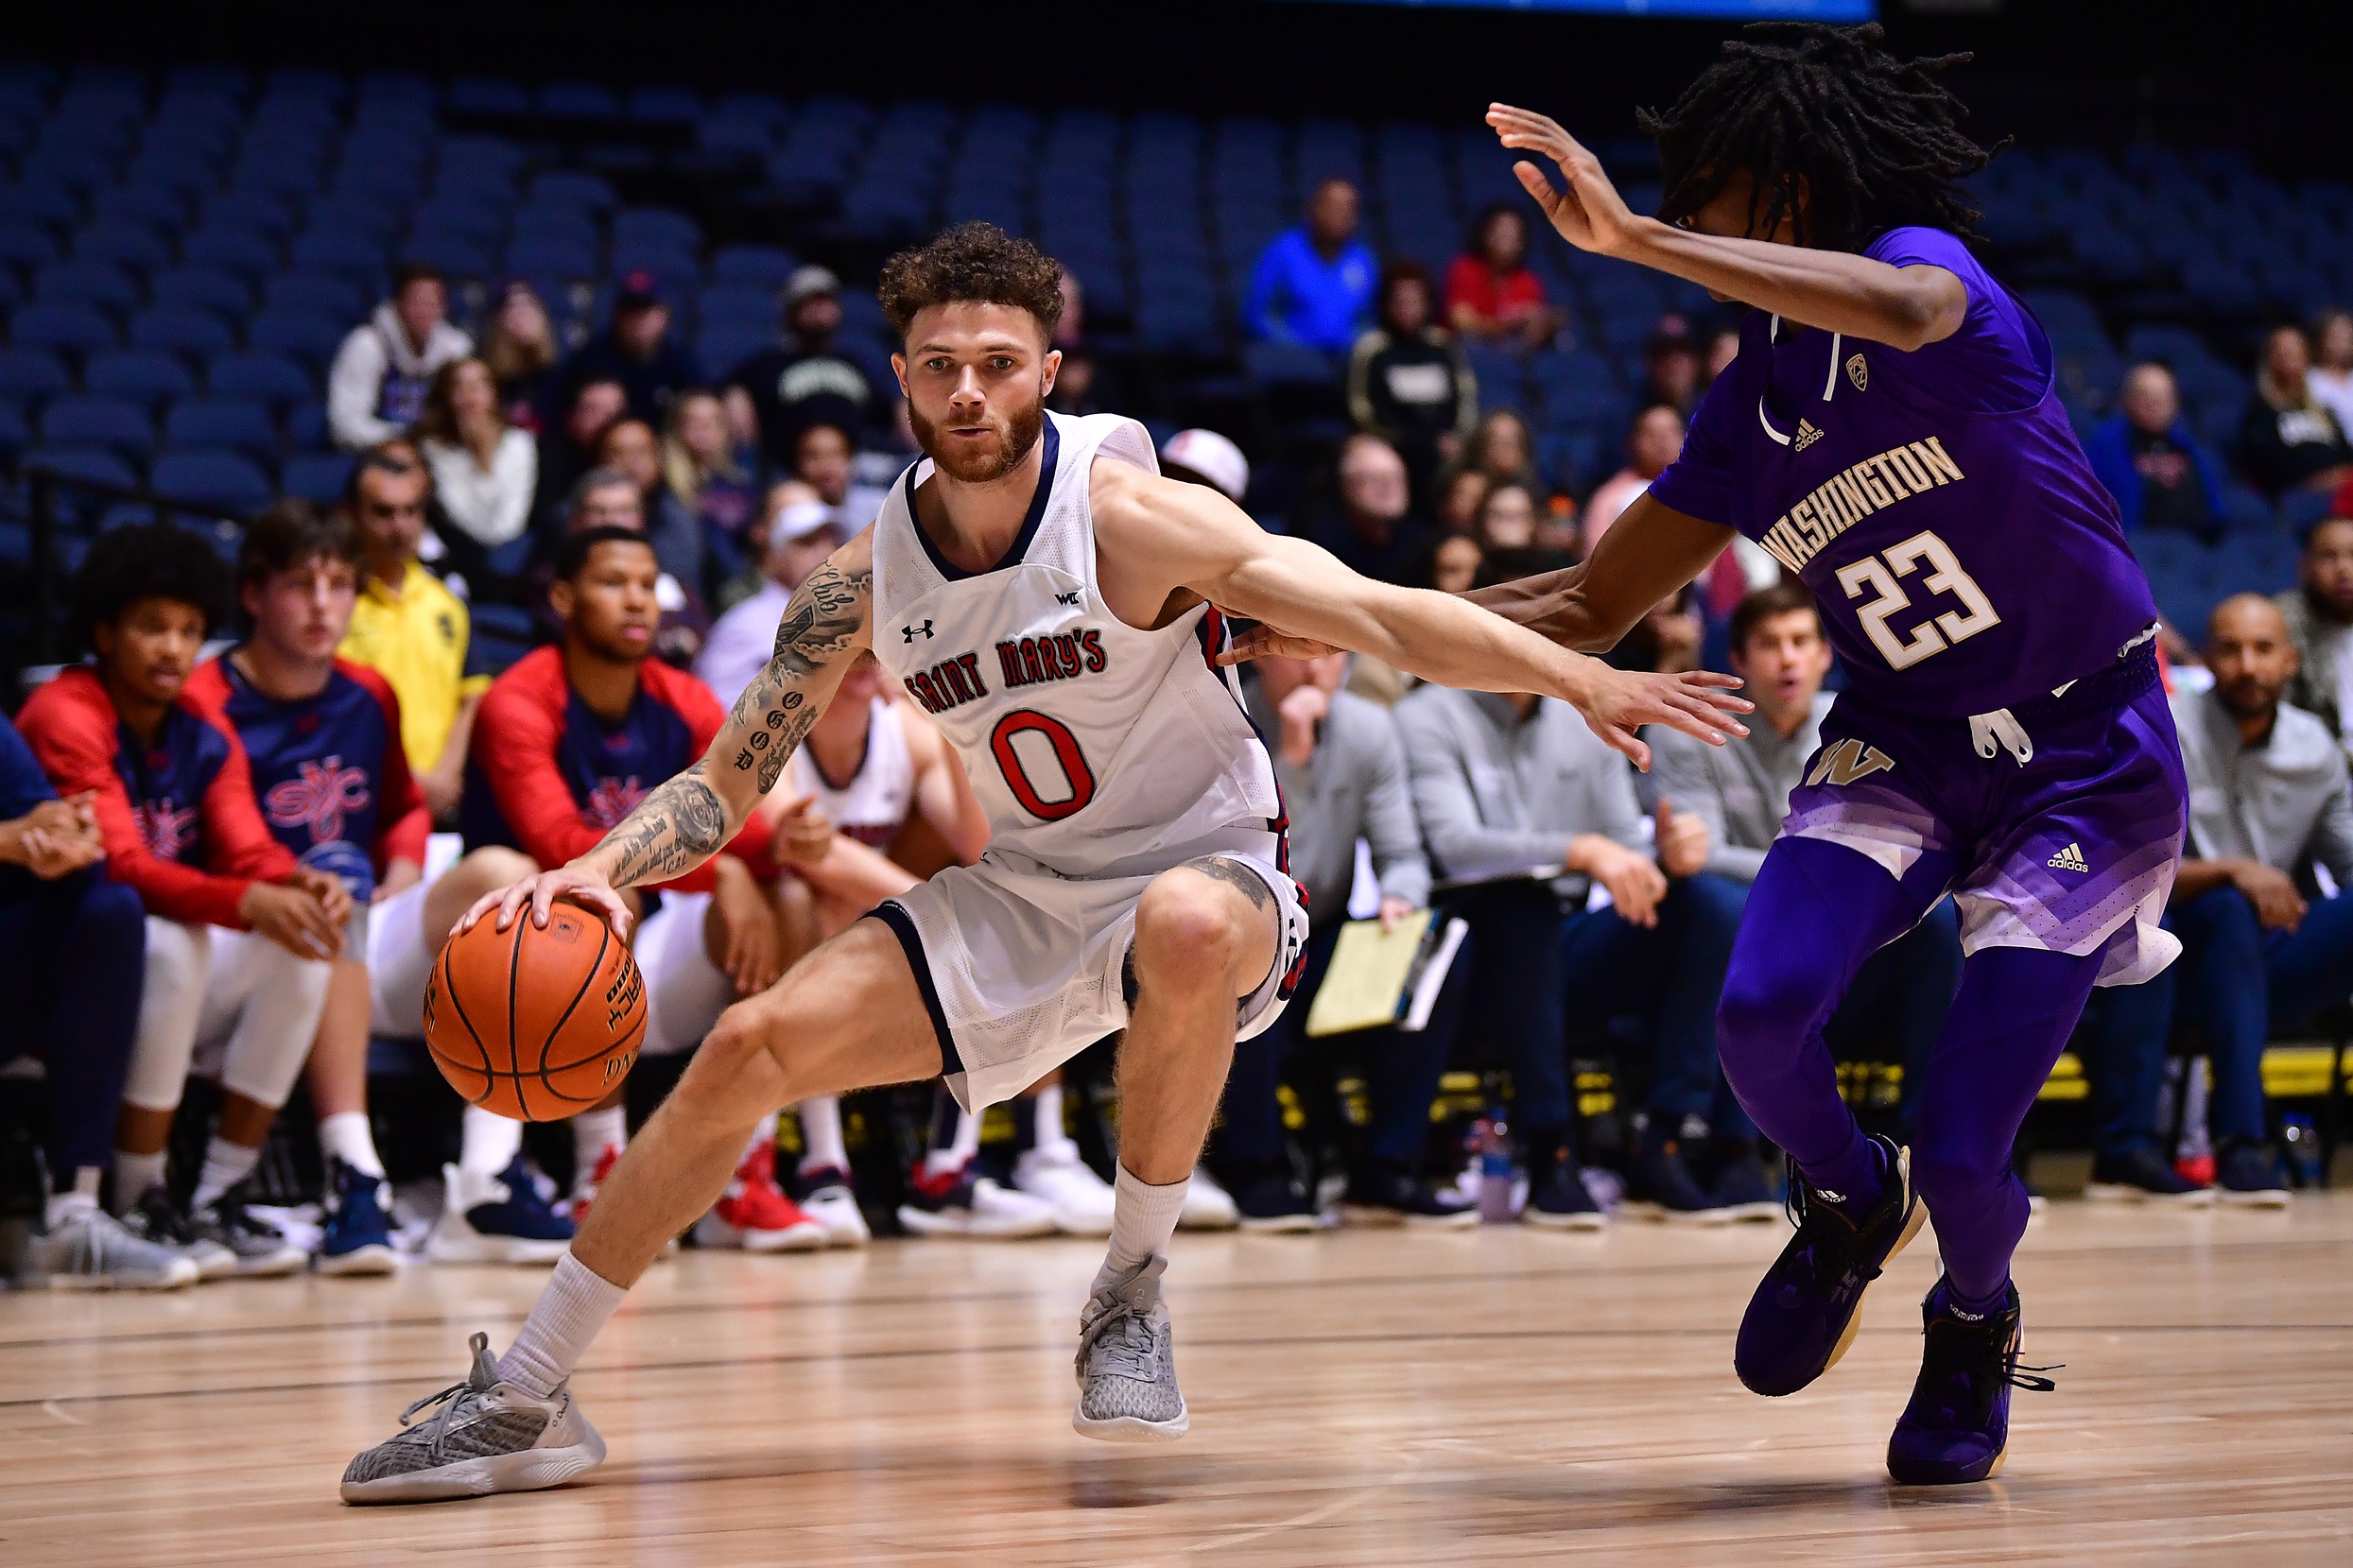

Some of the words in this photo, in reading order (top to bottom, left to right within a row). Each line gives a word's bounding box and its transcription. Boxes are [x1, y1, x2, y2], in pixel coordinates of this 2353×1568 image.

[1794, 428, 1825, 452] adidas
[1758, 436, 1965, 576] WASHINGTON
[1834, 529, 2002, 672] 23
[905, 651, 989, 714] SAINT
[995, 628, 1107, 688] MARY'S
[989, 707, 1098, 821] 0
[1805, 737, 1896, 787] W
[2046, 858, 2089, 873] adidas
